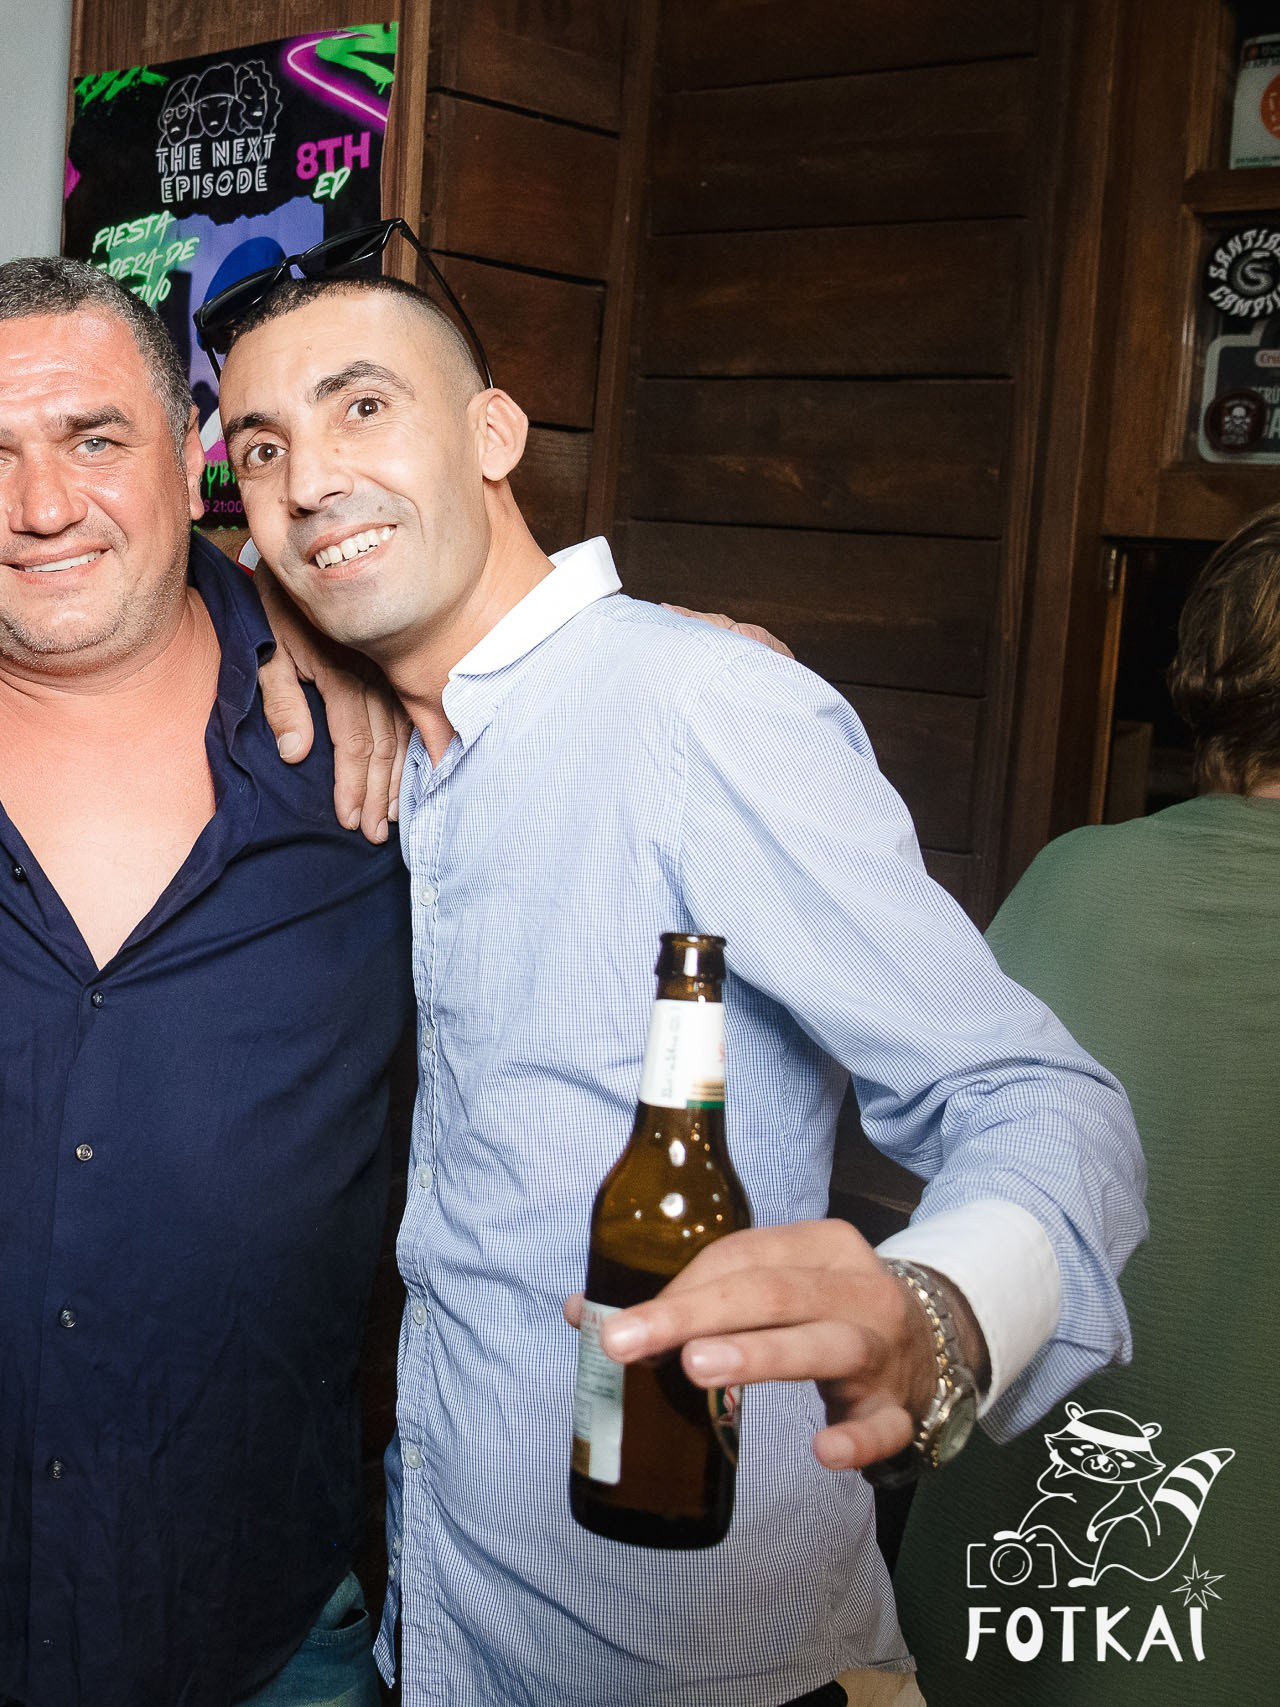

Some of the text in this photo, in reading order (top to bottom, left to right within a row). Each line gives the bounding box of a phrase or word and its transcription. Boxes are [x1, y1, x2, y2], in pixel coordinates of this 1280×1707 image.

[156, 134, 276, 174] THE NEXT
[295, 131, 371, 181] 8TH
[160, 166, 268, 203] EPISODE
[92, 210, 177, 253] FIESTA
[163, 237, 200, 267] DE
